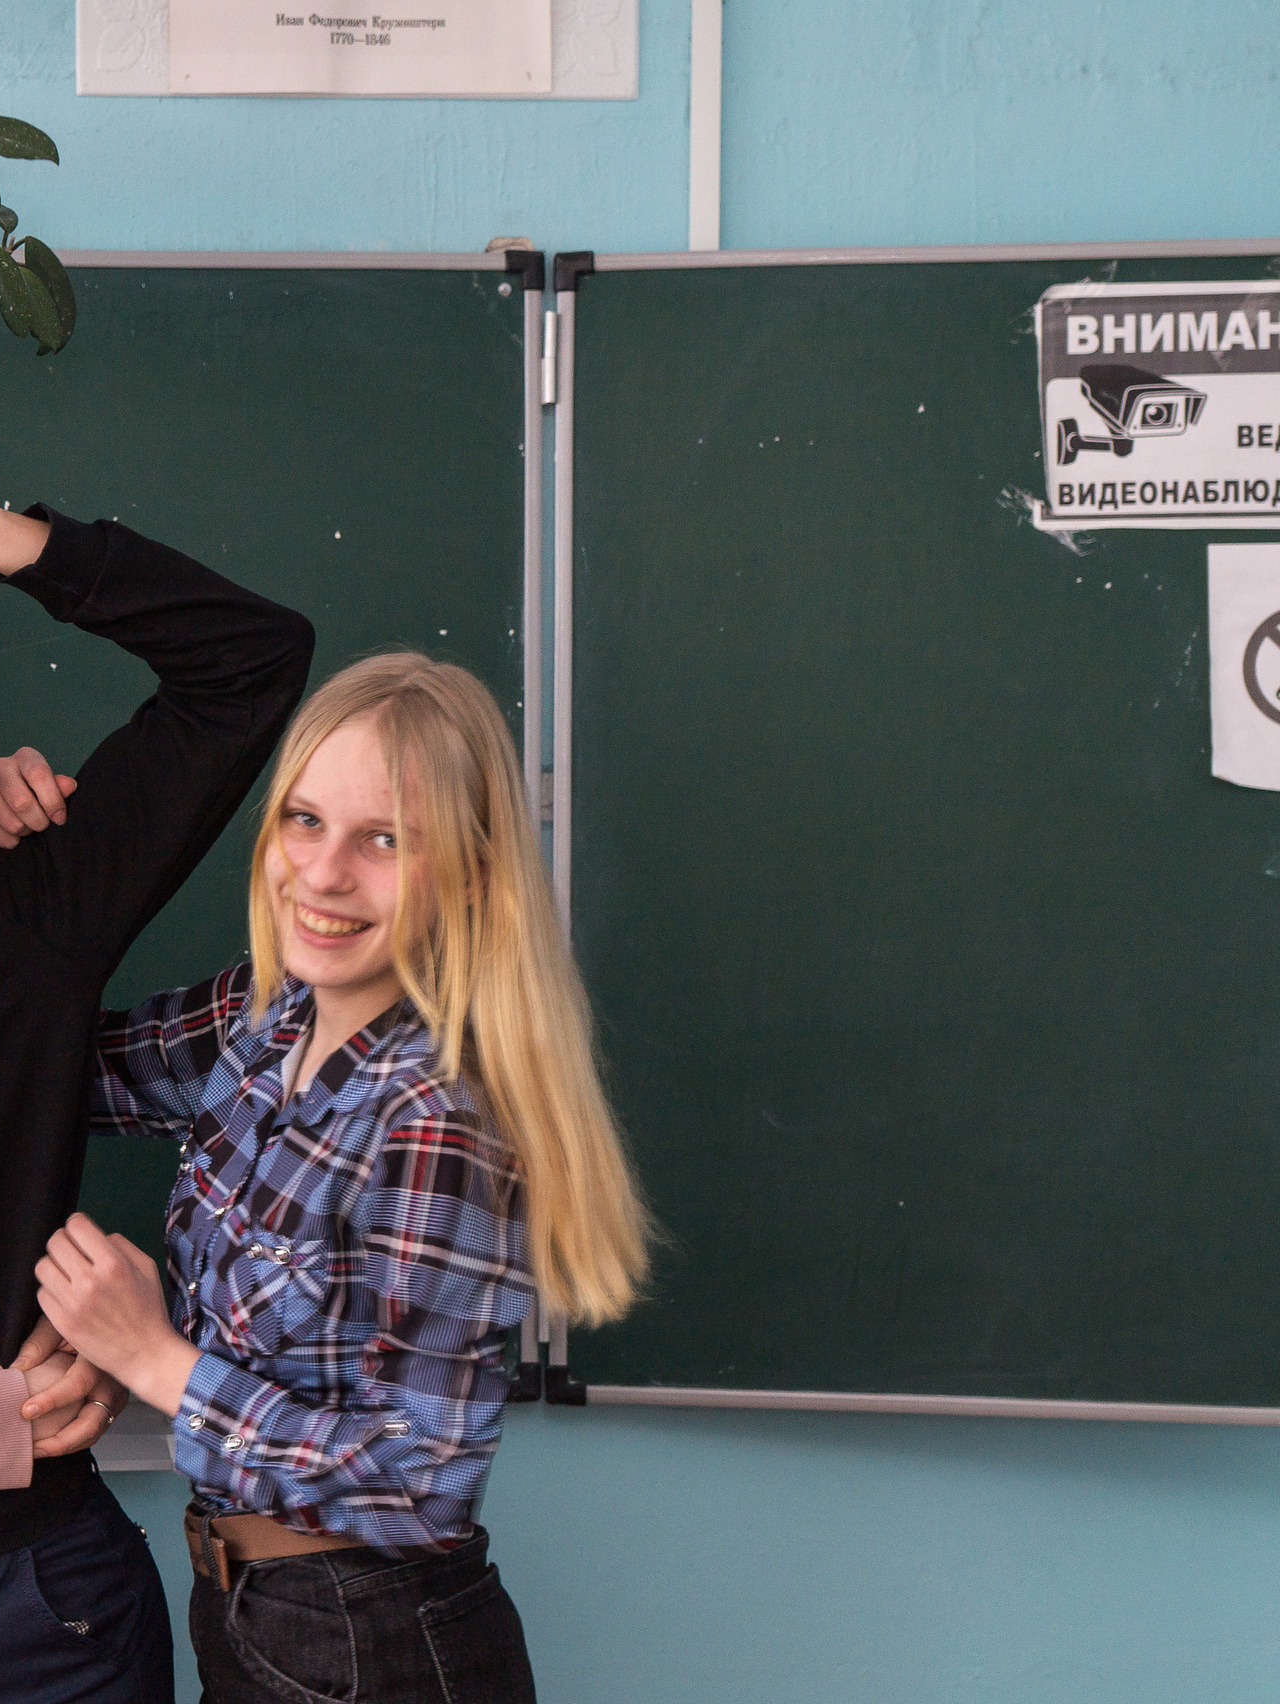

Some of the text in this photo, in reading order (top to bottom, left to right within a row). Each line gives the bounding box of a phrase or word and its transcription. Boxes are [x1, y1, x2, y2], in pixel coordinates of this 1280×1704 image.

[276, 14, 304, 26] Иван
[309, 14, 367, 28] Федорович
[1237, 424, 1280, 451] ВЕ
